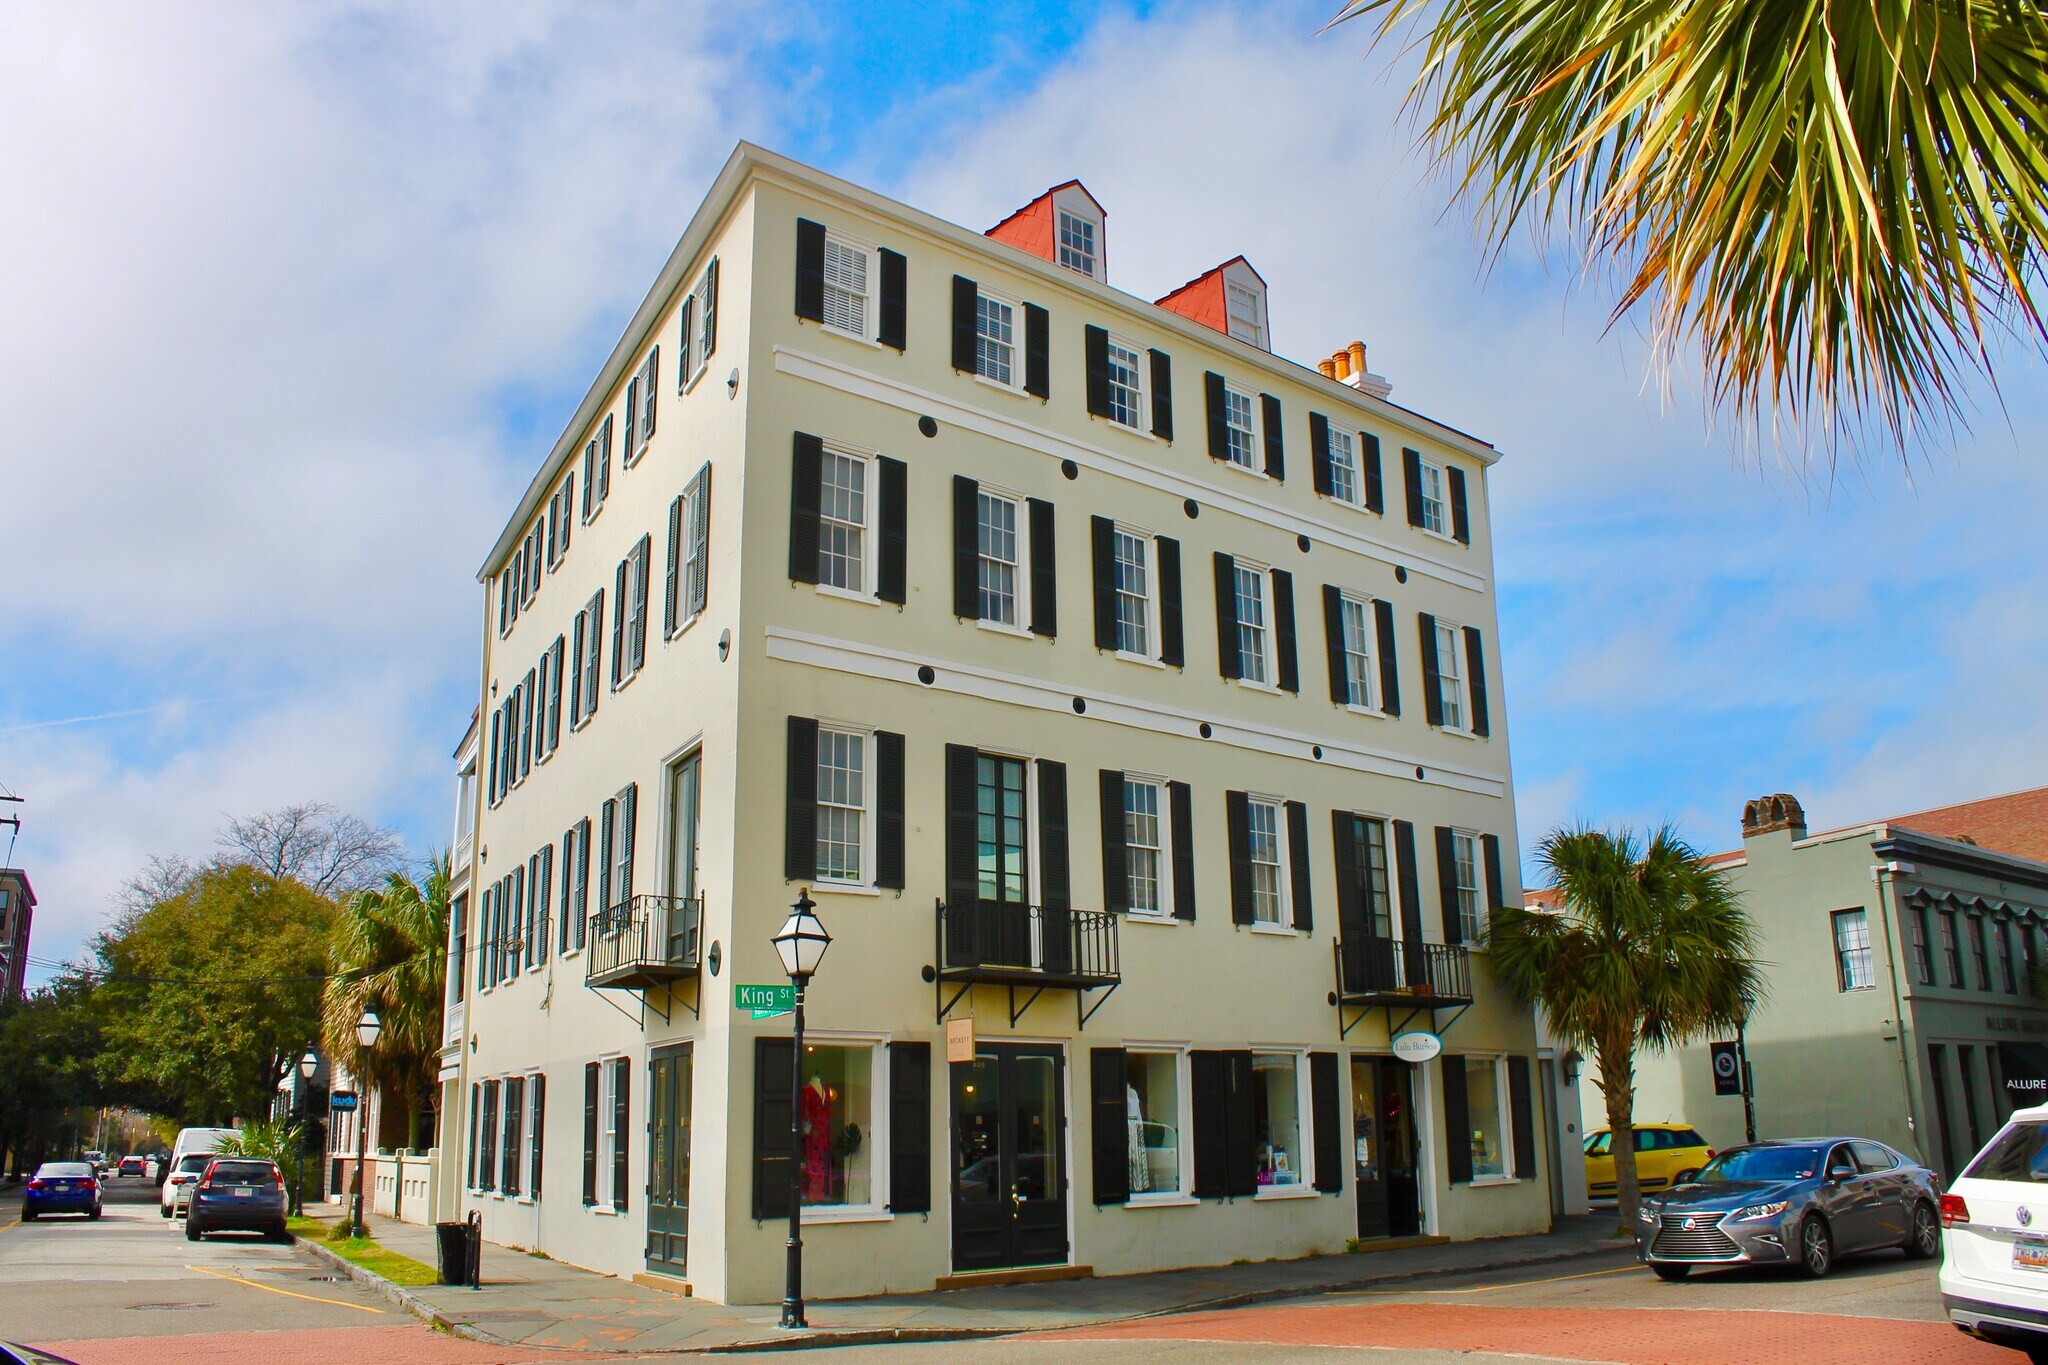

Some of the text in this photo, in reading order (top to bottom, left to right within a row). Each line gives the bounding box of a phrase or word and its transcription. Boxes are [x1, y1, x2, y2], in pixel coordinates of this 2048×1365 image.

[741, 987, 789, 1007] King St
[950, 1036, 969, 1044] BECKETT
[1395, 1042, 1411, 1051] Lulu
[2006, 1079, 2047, 1090] ALLURE
[332, 1095, 357, 1106] kudu
